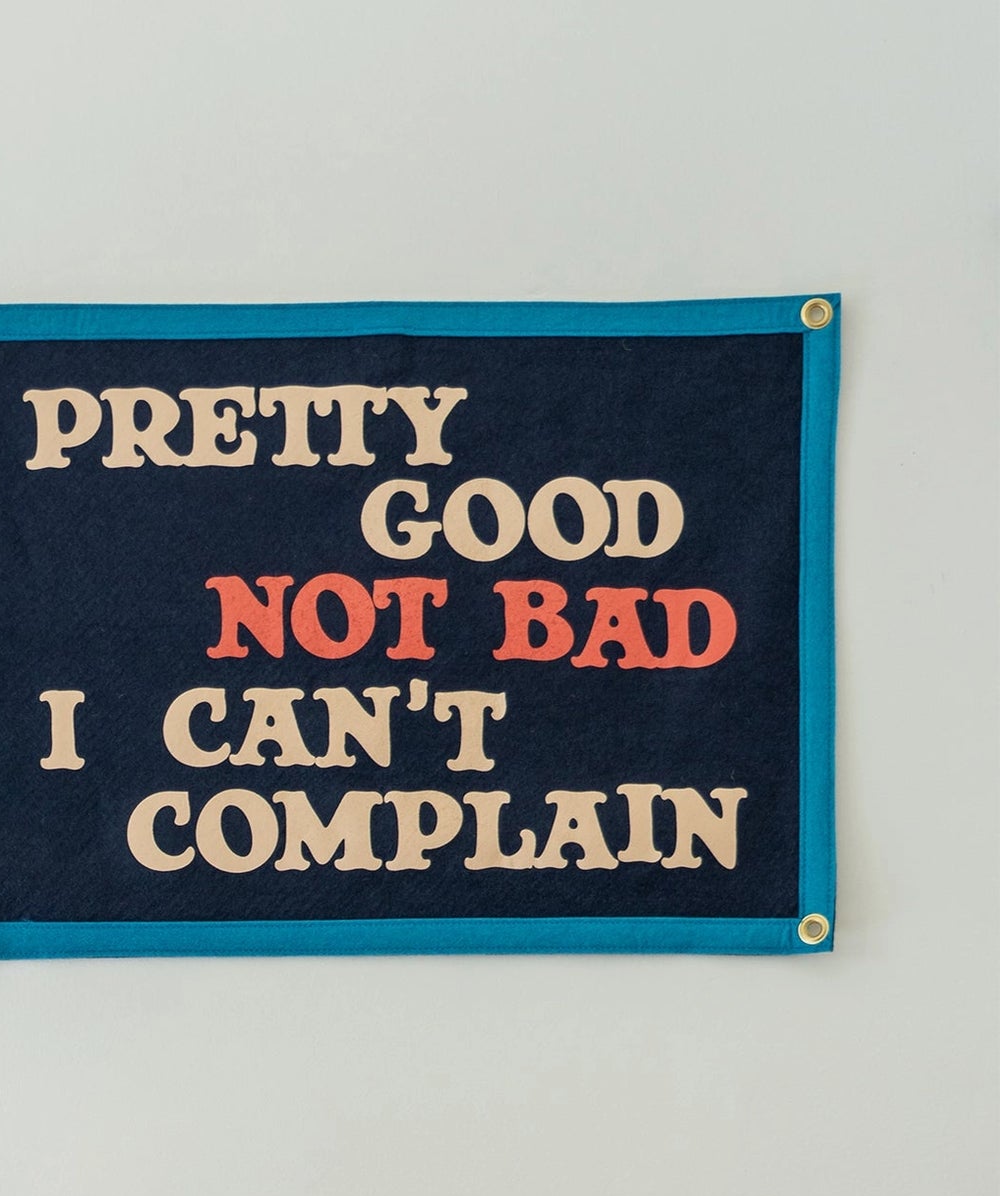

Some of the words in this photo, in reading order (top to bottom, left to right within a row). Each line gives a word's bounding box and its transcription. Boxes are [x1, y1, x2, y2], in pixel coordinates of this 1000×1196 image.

[23, 385, 468, 470] PRETTY
[360, 476, 684, 562] GOOD
[205, 573, 448, 660] NOT
[493, 579, 737, 669] BAD
[39, 690, 85, 770] I
[162, 678, 507, 772] CAN'T
[126, 784, 748, 872] COMPLAIN
